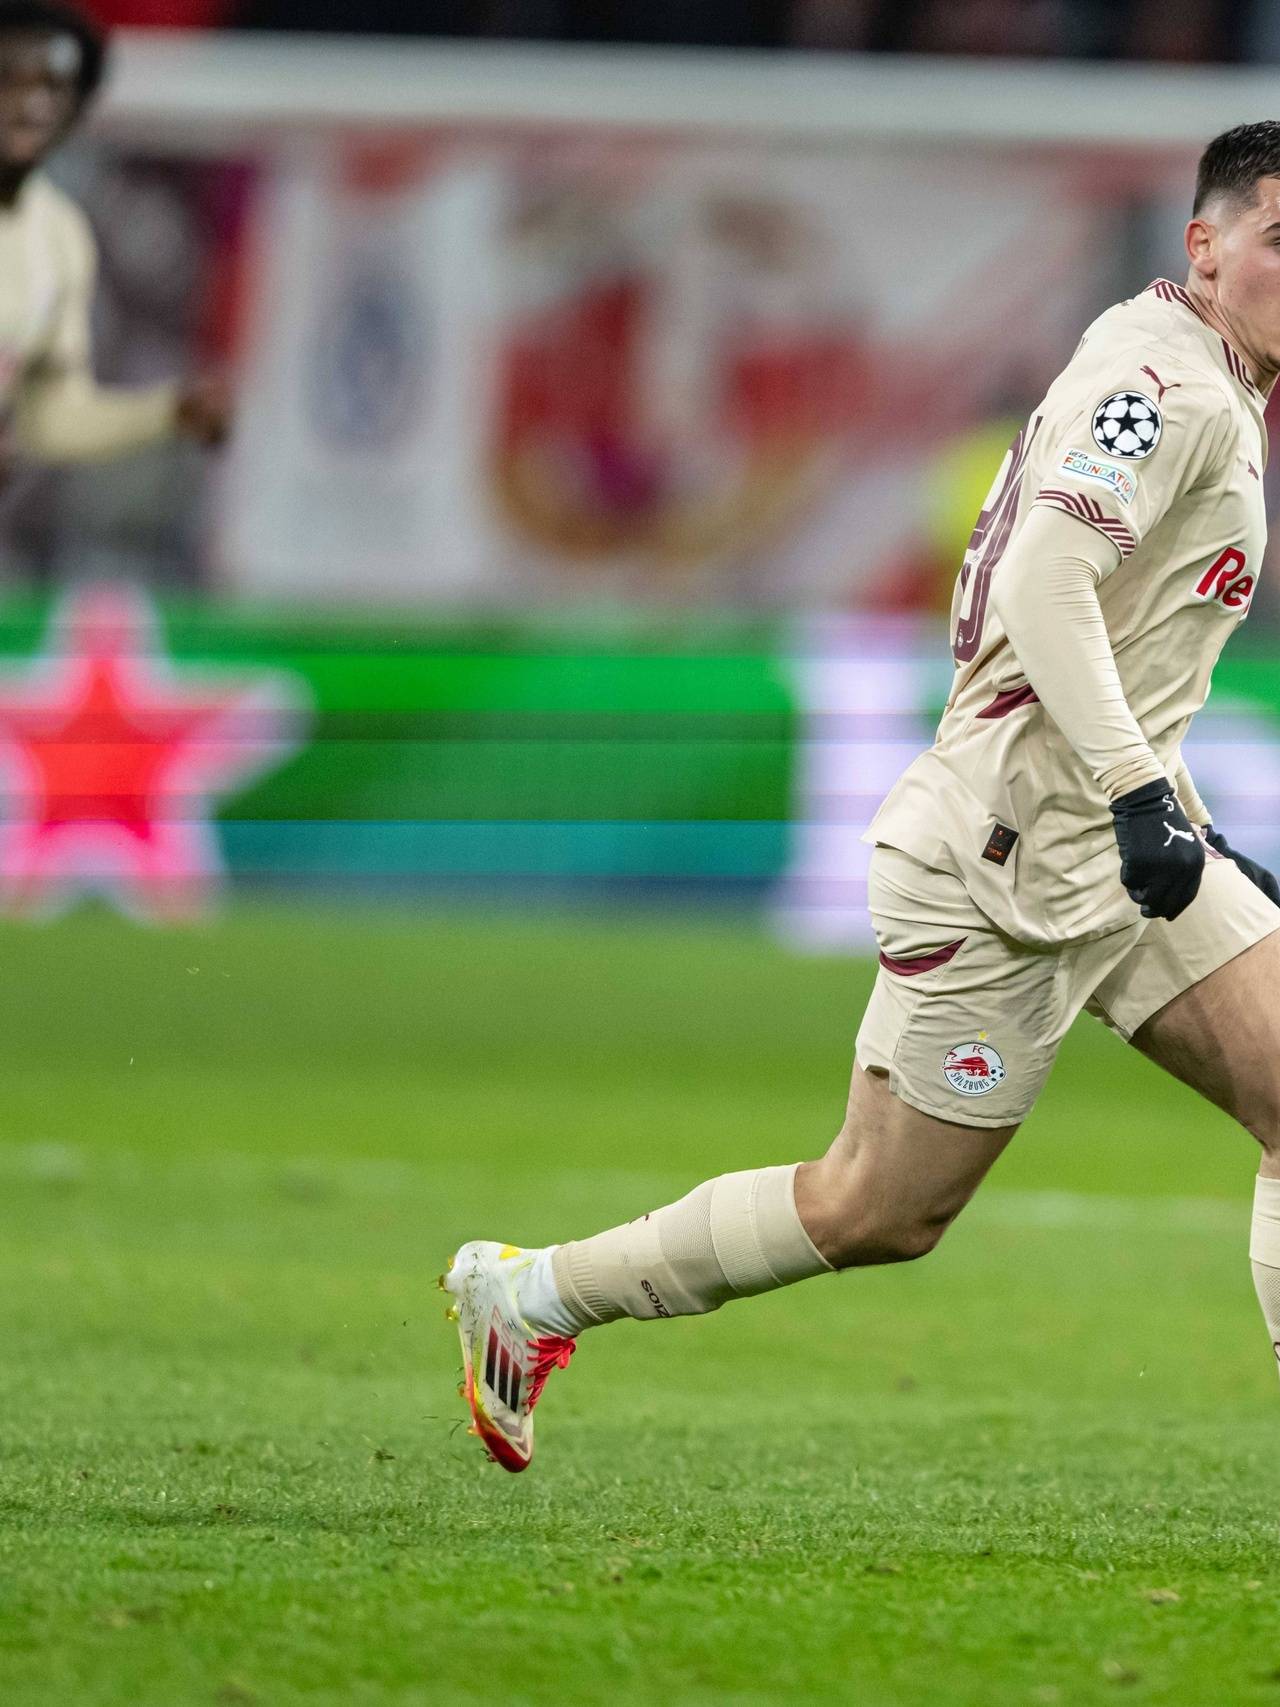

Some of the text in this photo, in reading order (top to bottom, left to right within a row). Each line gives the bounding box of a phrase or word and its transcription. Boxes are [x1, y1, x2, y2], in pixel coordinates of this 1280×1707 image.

[1195, 546, 1254, 614] Re
[972, 1045, 985, 1055] FC
[950, 1071, 990, 1091] SALZBURG
